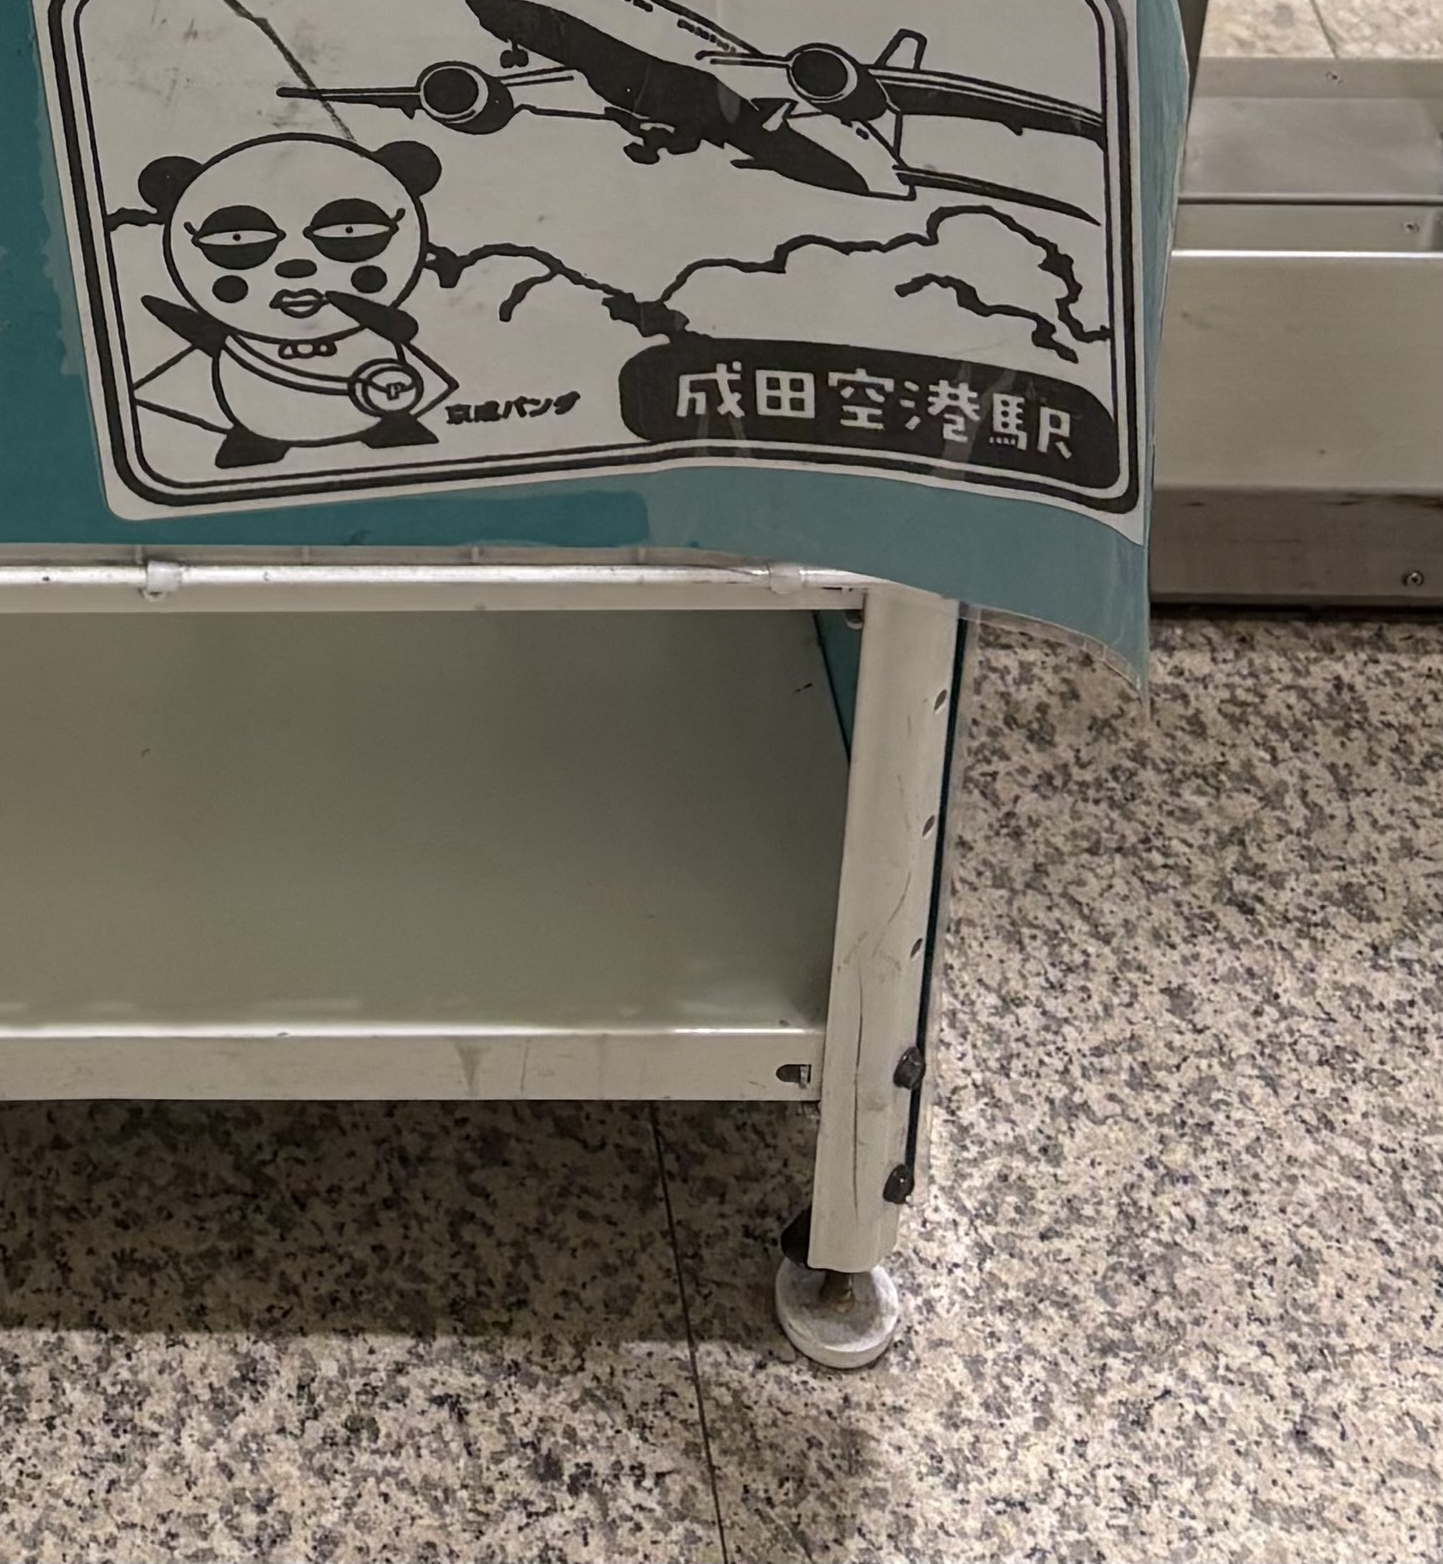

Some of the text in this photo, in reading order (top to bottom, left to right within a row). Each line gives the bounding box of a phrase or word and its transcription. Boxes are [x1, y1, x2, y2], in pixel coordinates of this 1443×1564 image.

[676, 359, 1074, 460] 成田空港駅
